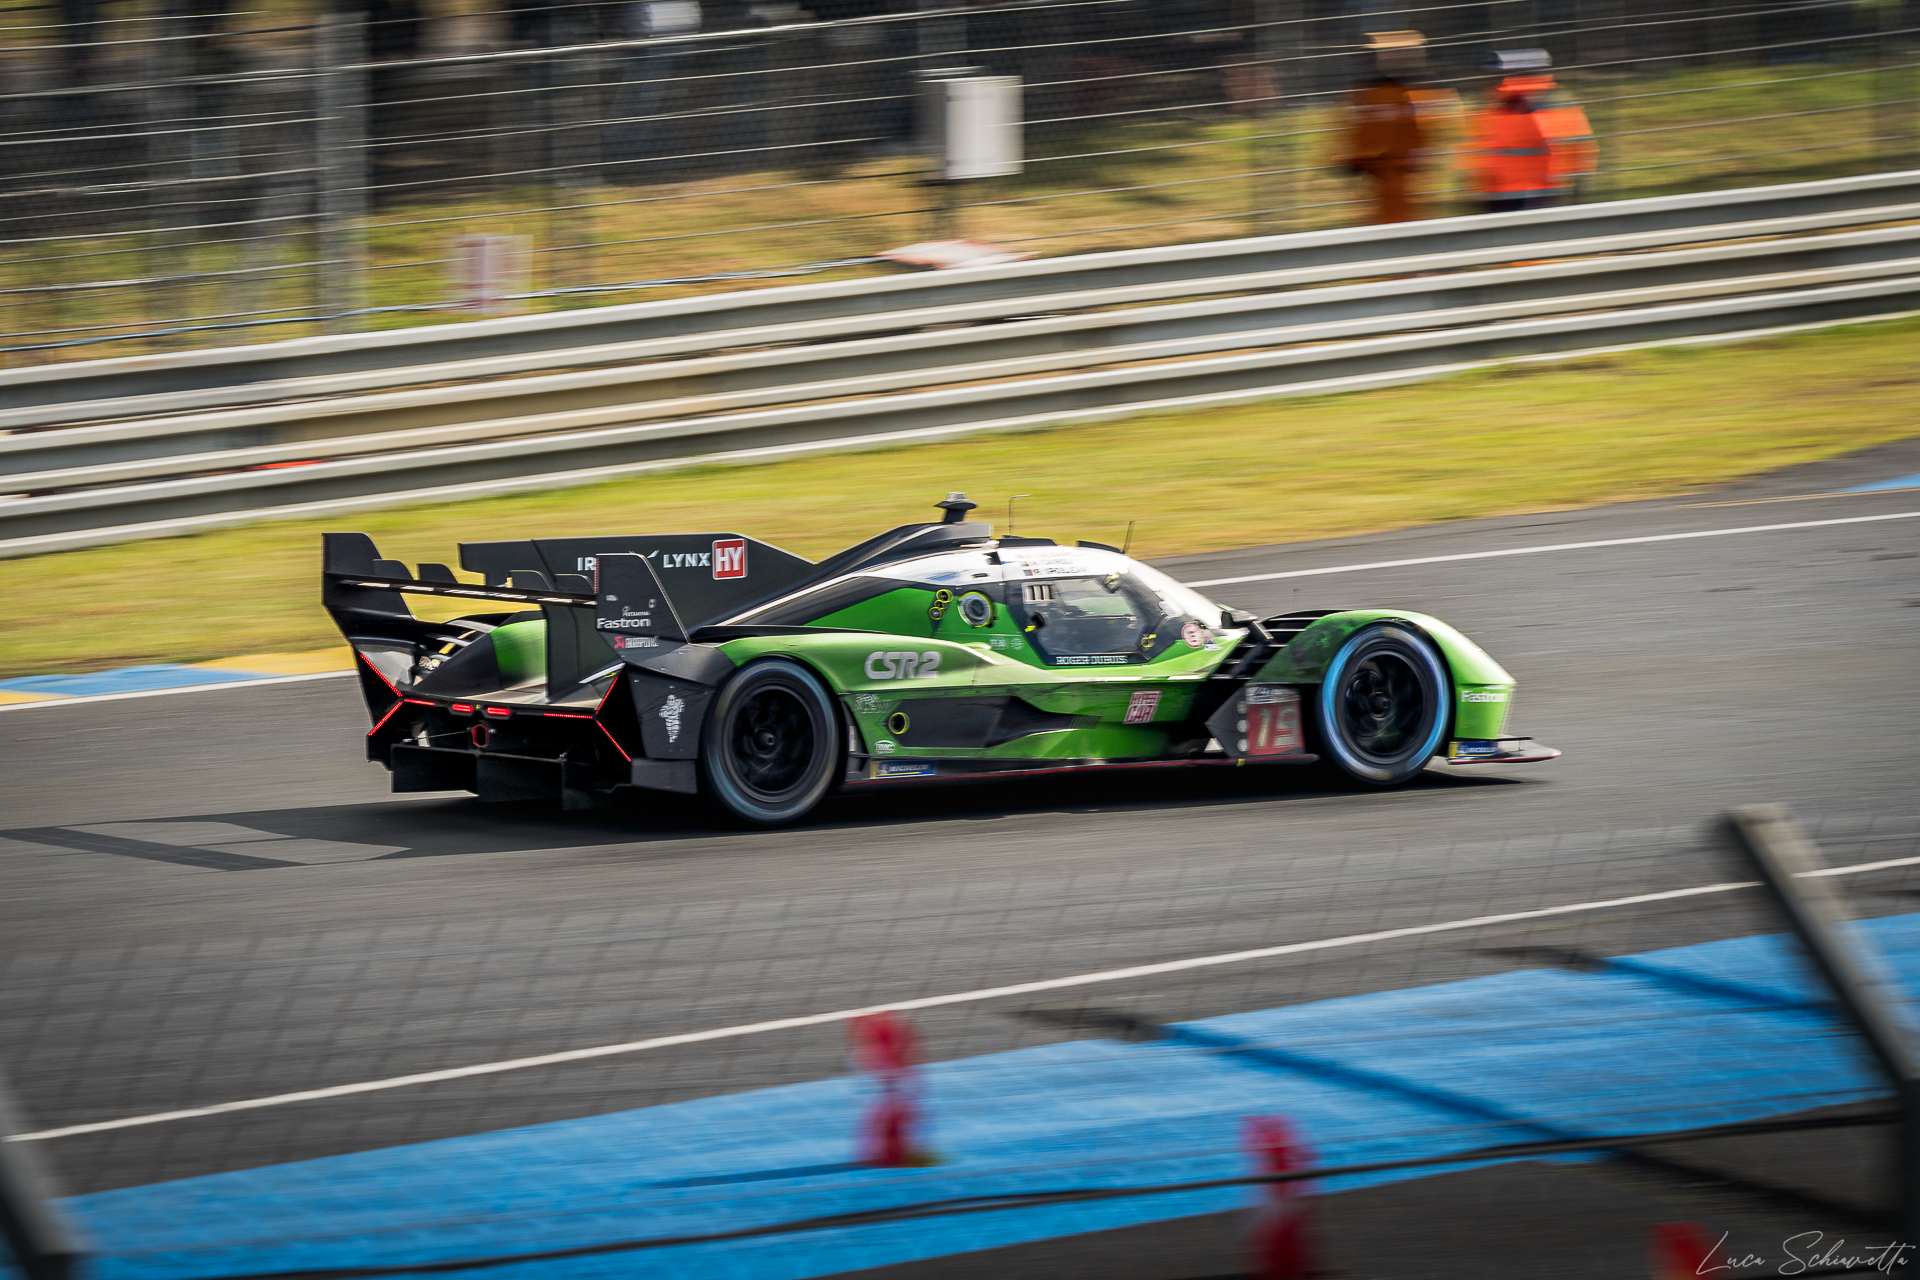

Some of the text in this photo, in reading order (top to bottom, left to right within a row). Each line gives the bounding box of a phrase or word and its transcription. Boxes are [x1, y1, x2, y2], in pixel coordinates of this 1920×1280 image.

[577, 552, 711, 571] IR LYNX
[715, 547, 743, 572] HY
[597, 617, 652, 629] Fastron
[865, 651, 942, 680] CSR2
[1056, 656, 1090, 665] ROGER
[1461, 690, 1508, 703] Fastron
[1256, 705, 1300, 748] 19
[888, 764, 931, 773] MICHELIN
